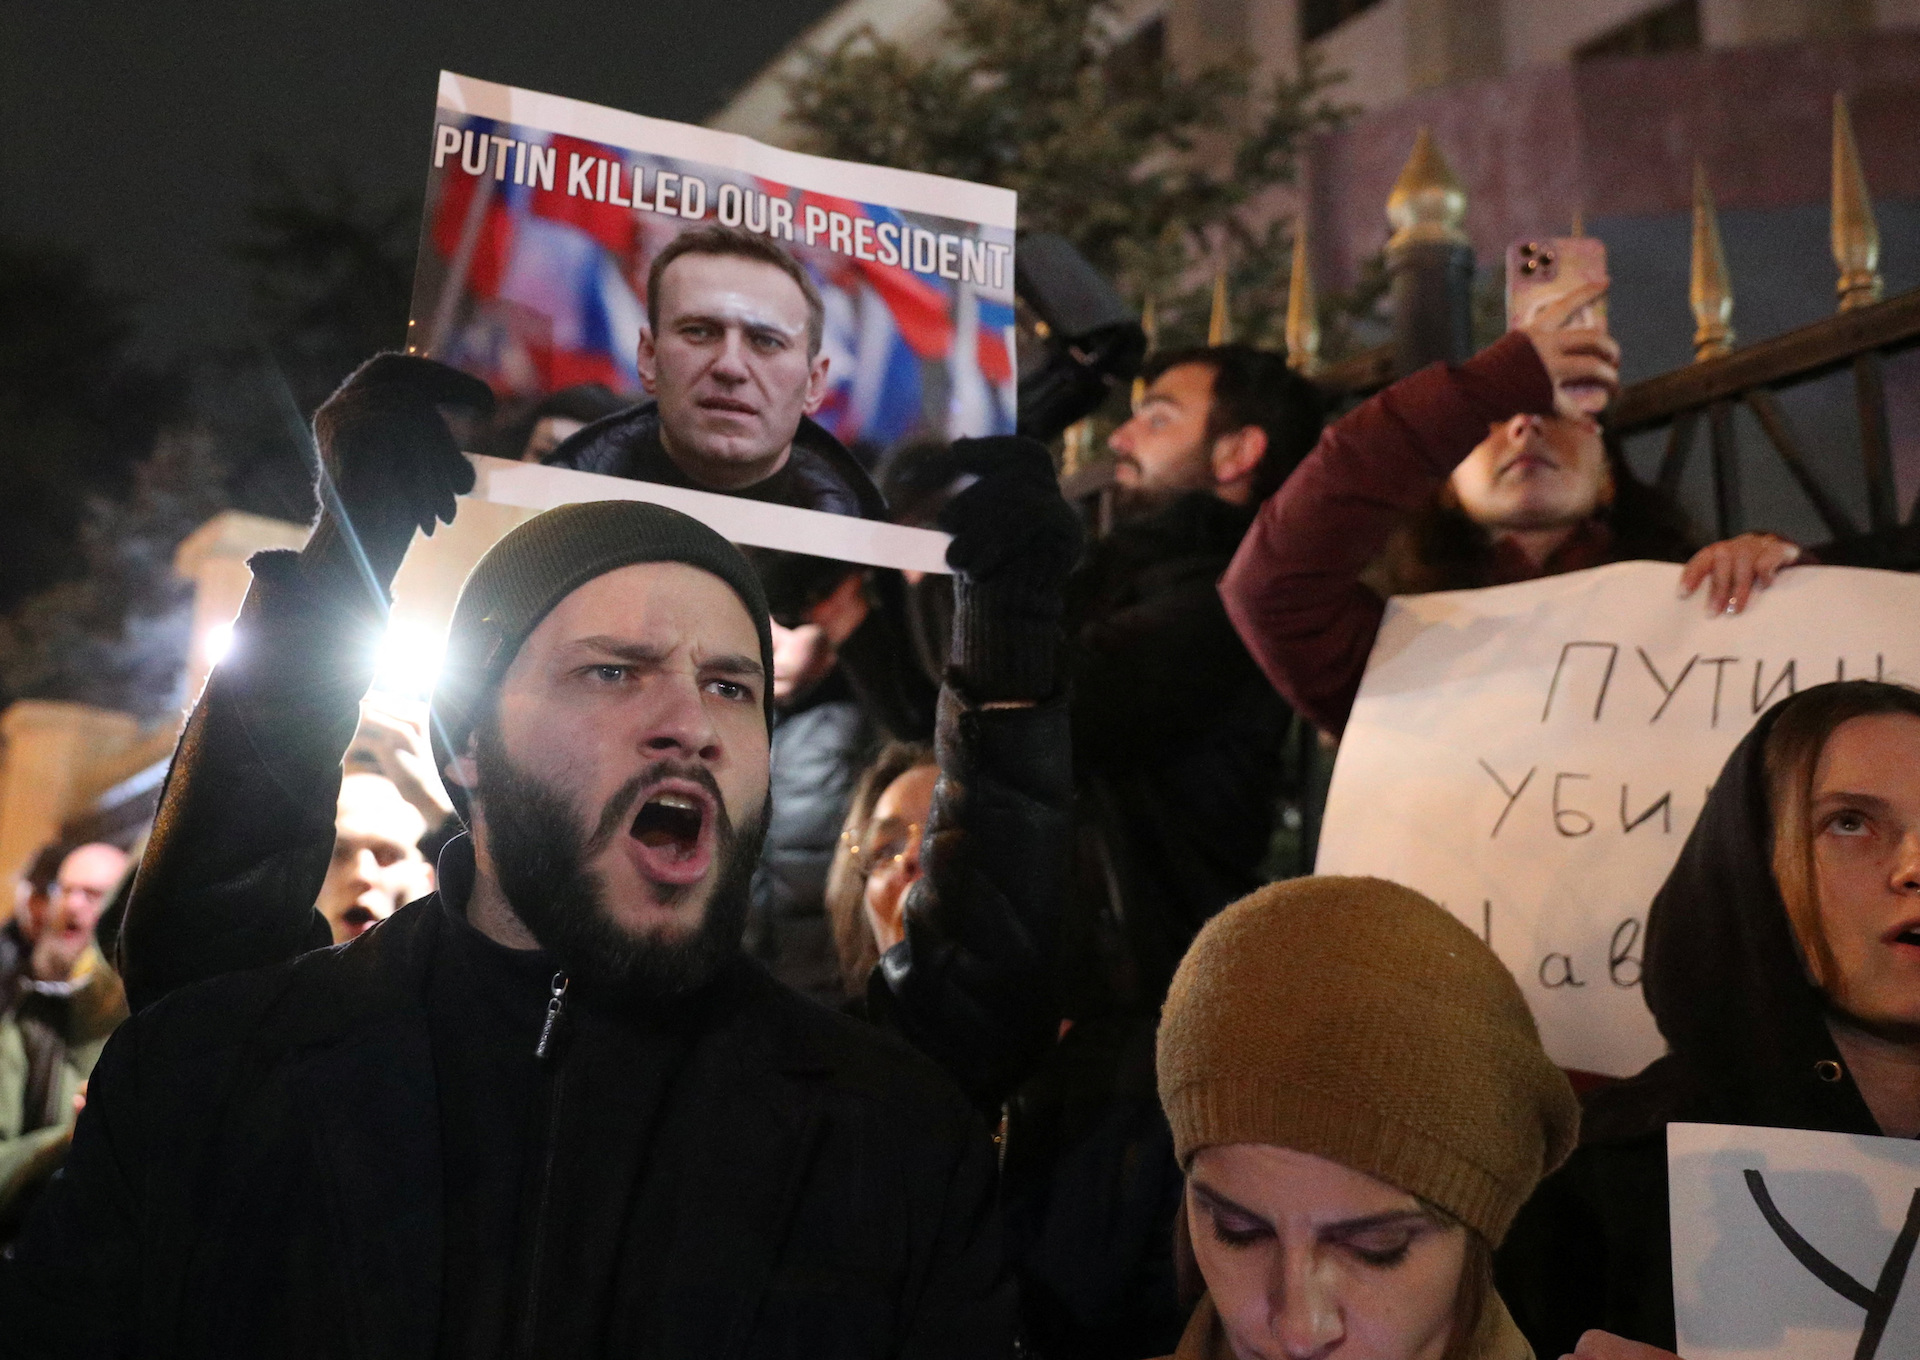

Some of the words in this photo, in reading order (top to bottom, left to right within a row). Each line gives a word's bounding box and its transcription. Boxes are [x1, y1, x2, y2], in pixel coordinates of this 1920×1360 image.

[434, 124, 557, 191] PUTIN
[567, 152, 706, 220] KILLED
[718, 184, 794, 242] OUR
[805, 204, 1010, 288] PRESIDENT
[1478, 758, 1713, 839] УБИ
